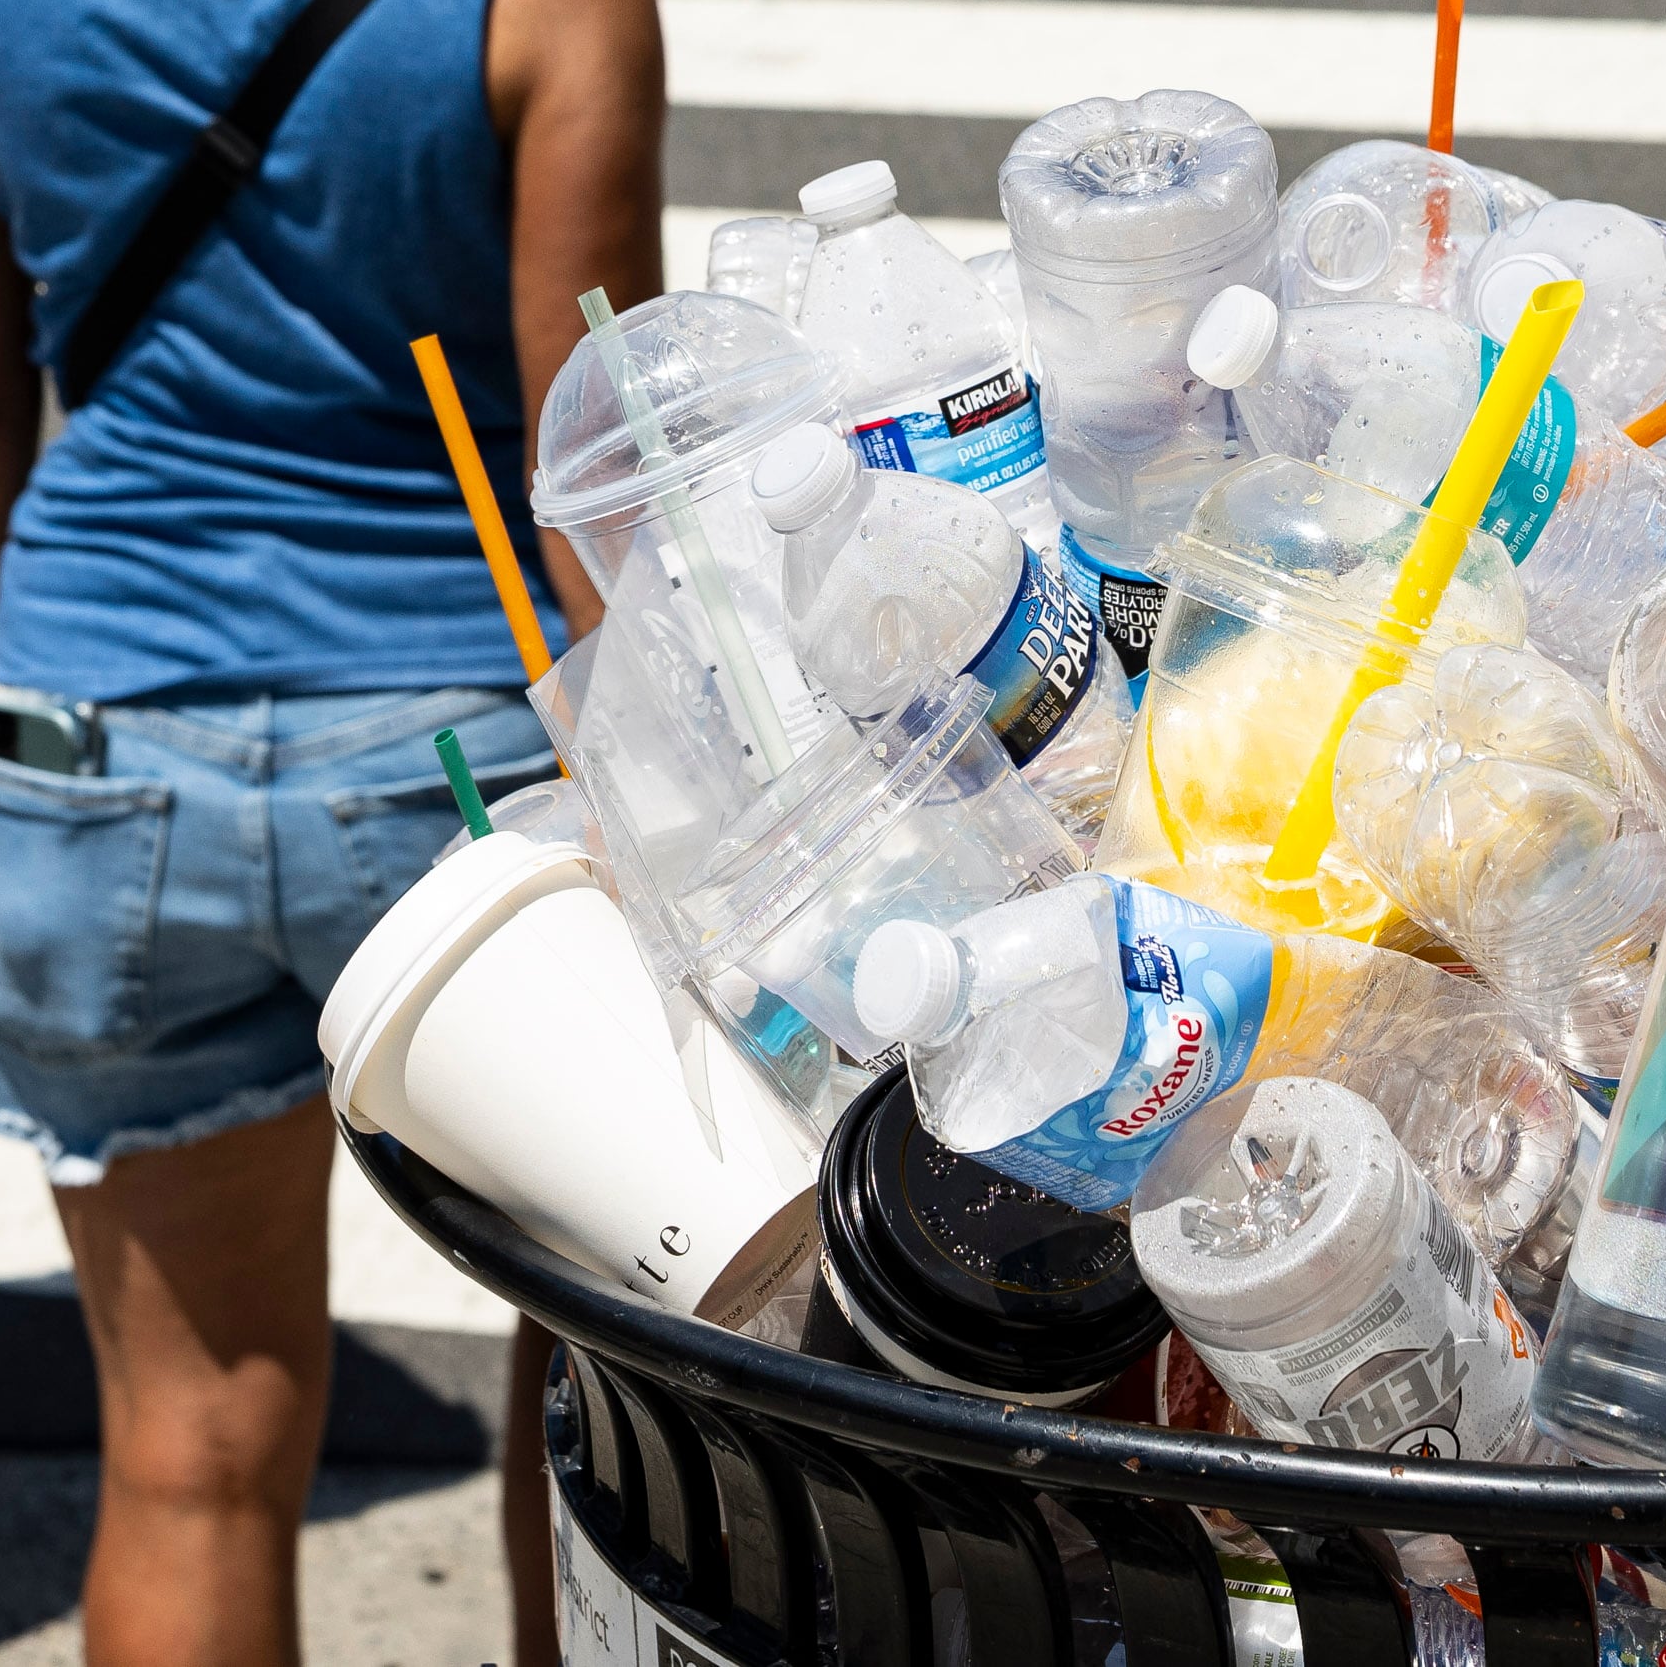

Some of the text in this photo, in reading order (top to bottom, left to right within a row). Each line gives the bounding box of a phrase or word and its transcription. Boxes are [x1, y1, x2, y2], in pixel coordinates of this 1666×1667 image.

[956, 423, 1019, 467] purified
[1000, 463, 1015, 479] OZ
[1518, 521, 1533, 534] 500
[1526, 512, 1538, 522] mL
[1103, 579, 1156, 596] SPORTS DRINK
[1021, 560, 1065, 675] DEER
[1024, 602, 1038, 624] EST.
[1045, 584, 1093, 702] PARK
[1026, 690, 1056, 725] 16.9 FL OZ
[1034, 717, 1054, 735] (500
[1132, 951, 1148, 987] PROUDLY
[1144, 959, 1157, 988] BOTTLED
[1103, 1016, 1202, 1135] Roxane
[1158, 1046, 1210, 1123] PURIFIED WATER
[754, 1275, 774, 1296] Drink
[727, 1305, 744, 1321] CUP
[1389, 1304, 1413, 1328] ZERO
[1287, 1299, 1396, 1371] GLACIER CHERRY
[1362, 1321, 1394, 1349] SUGAR
[1332, 1342, 1365, 1368] THIRST
[1286, 1360, 1335, 1388] QUENCHER
